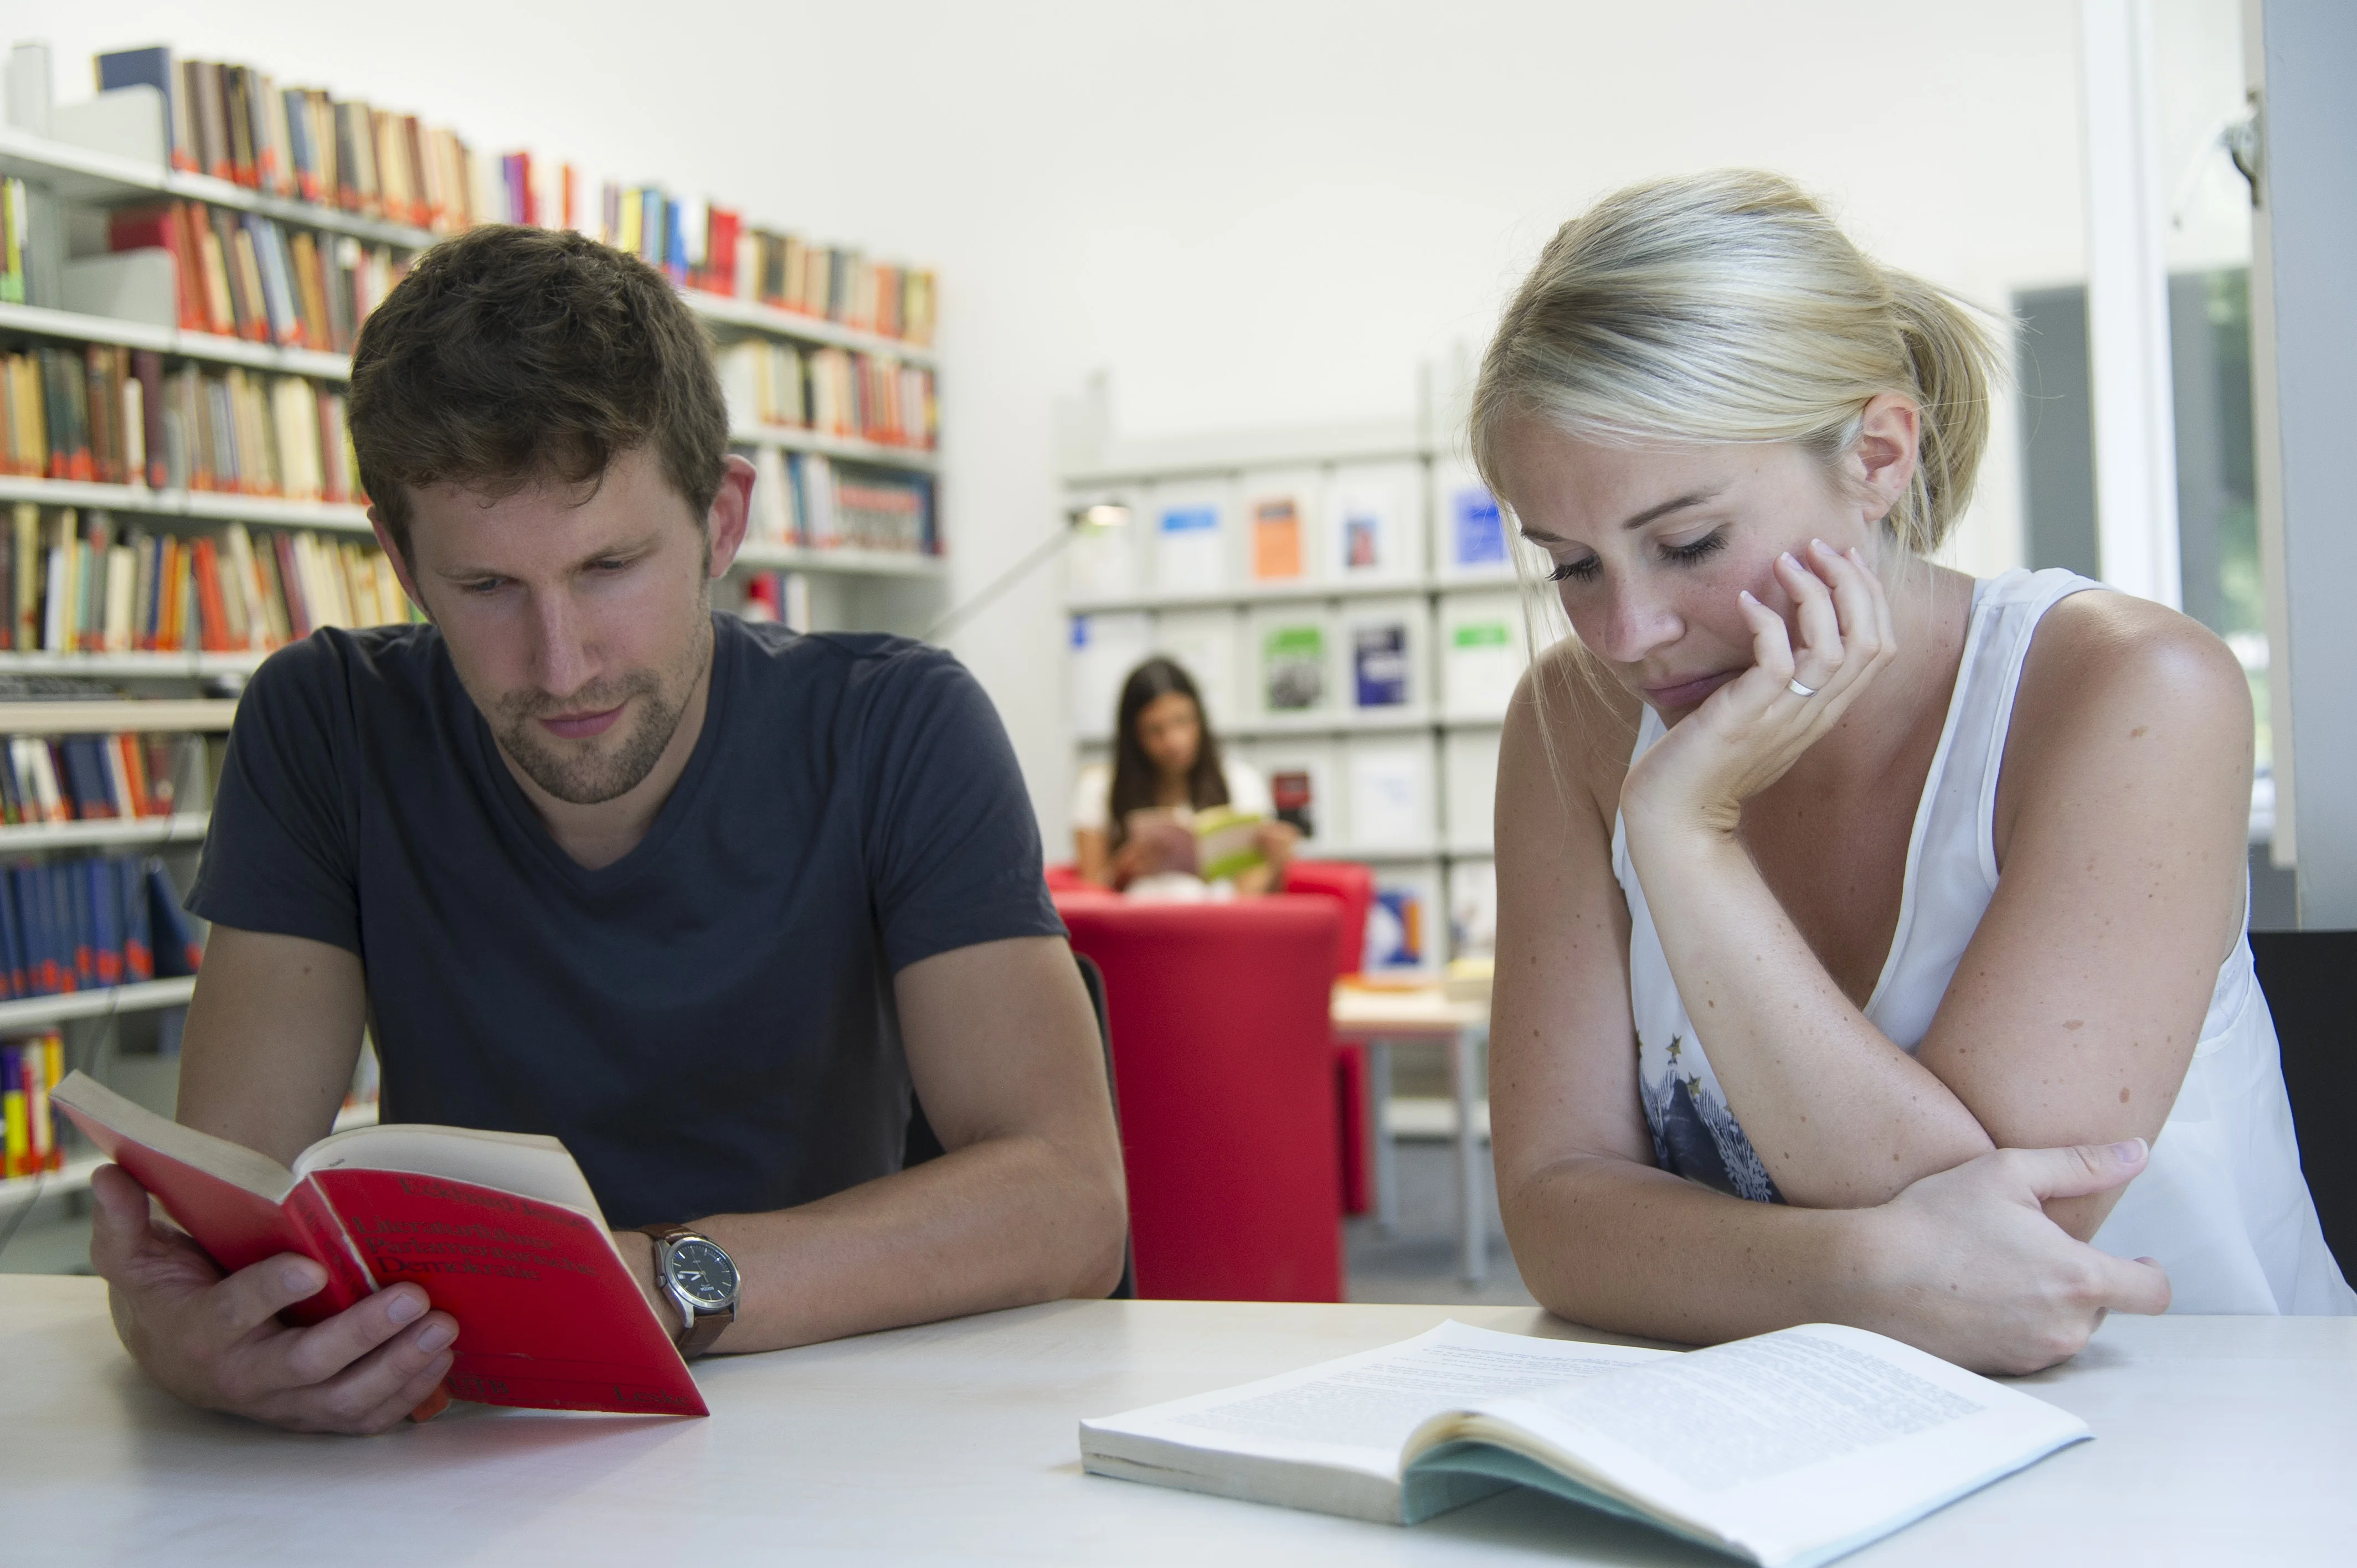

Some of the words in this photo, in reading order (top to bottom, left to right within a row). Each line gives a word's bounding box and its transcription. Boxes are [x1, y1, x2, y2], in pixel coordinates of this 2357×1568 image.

[376, 1257, 543, 1281] Demokratie
[446, 1376, 509, 1394] UTB
[613, 1385, 692, 1406] Leske
